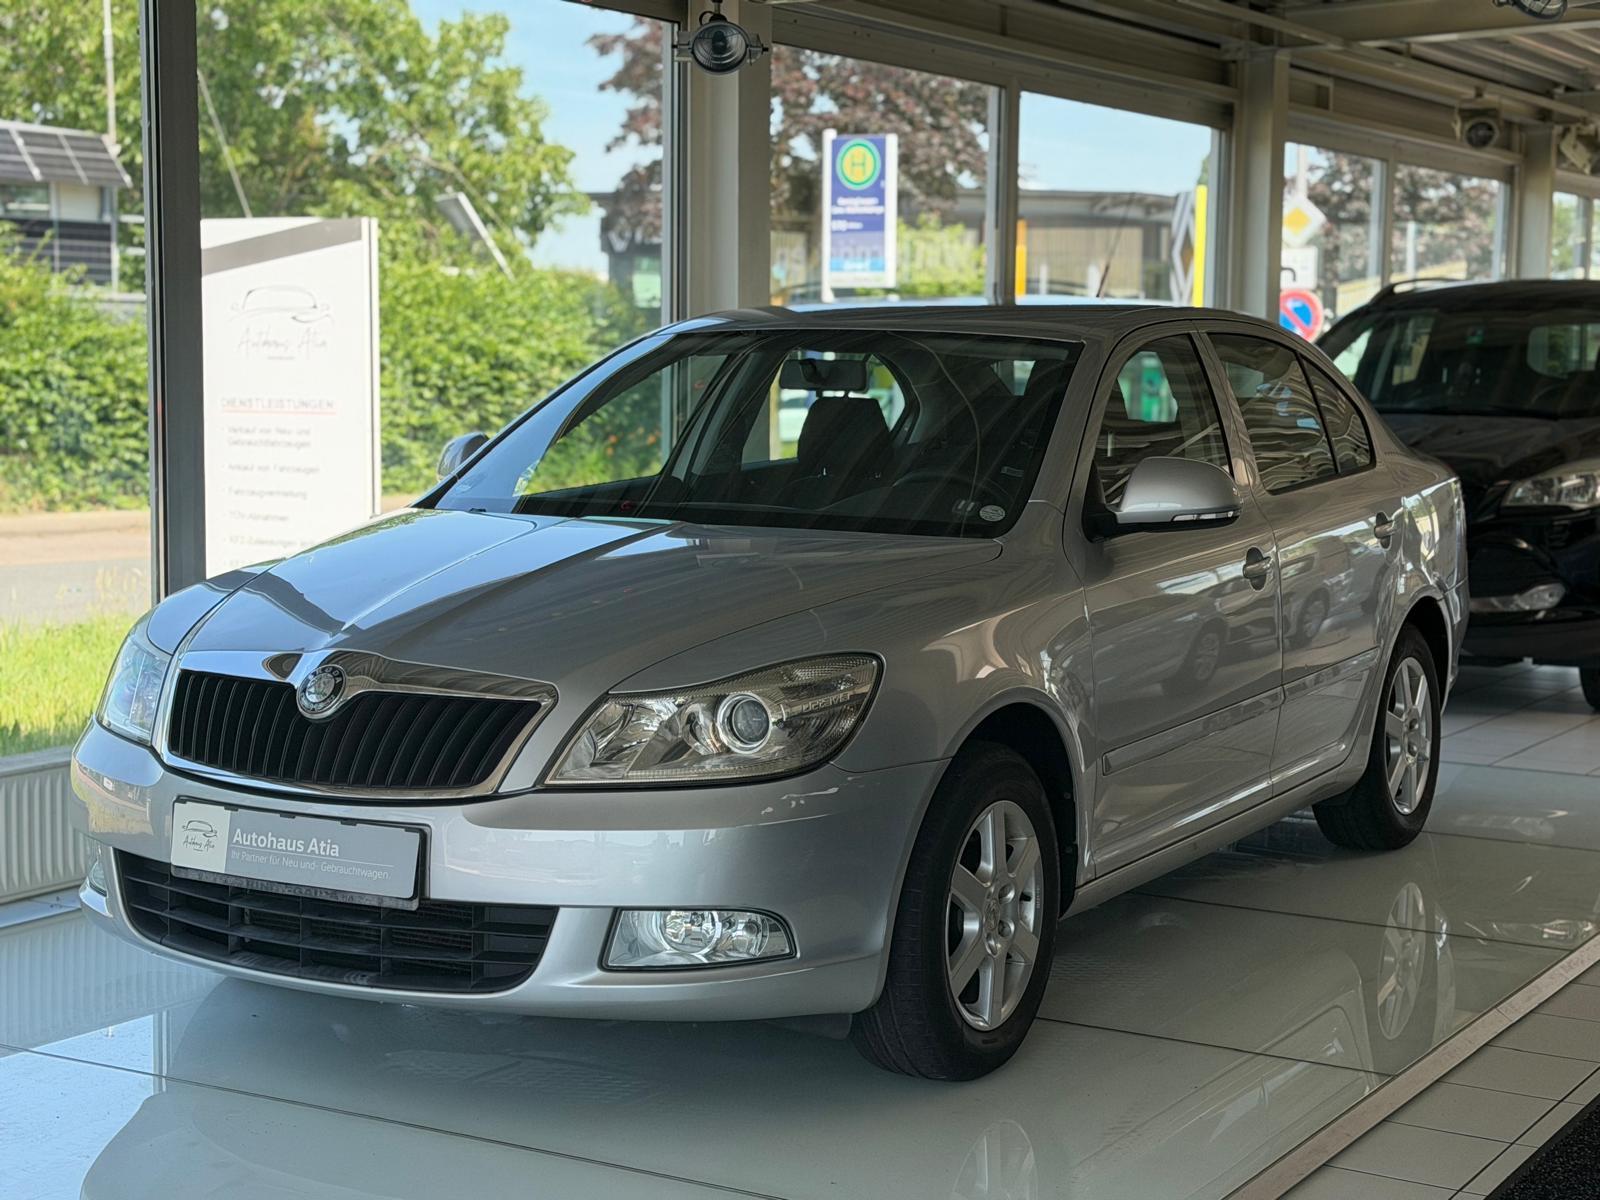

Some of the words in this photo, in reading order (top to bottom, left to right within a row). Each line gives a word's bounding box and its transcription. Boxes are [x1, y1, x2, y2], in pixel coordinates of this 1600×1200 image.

[221, 397, 335, 409] DIENSTLEISTUNGEN
[232, 828, 305, 853] Autohaus
[307, 838, 340, 857] Atia
[231, 850, 240, 860] Ihr
[241, 851, 268, 864] Partner
[269, 854, 280, 865] für
[282, 857, 299, 868] Neu
